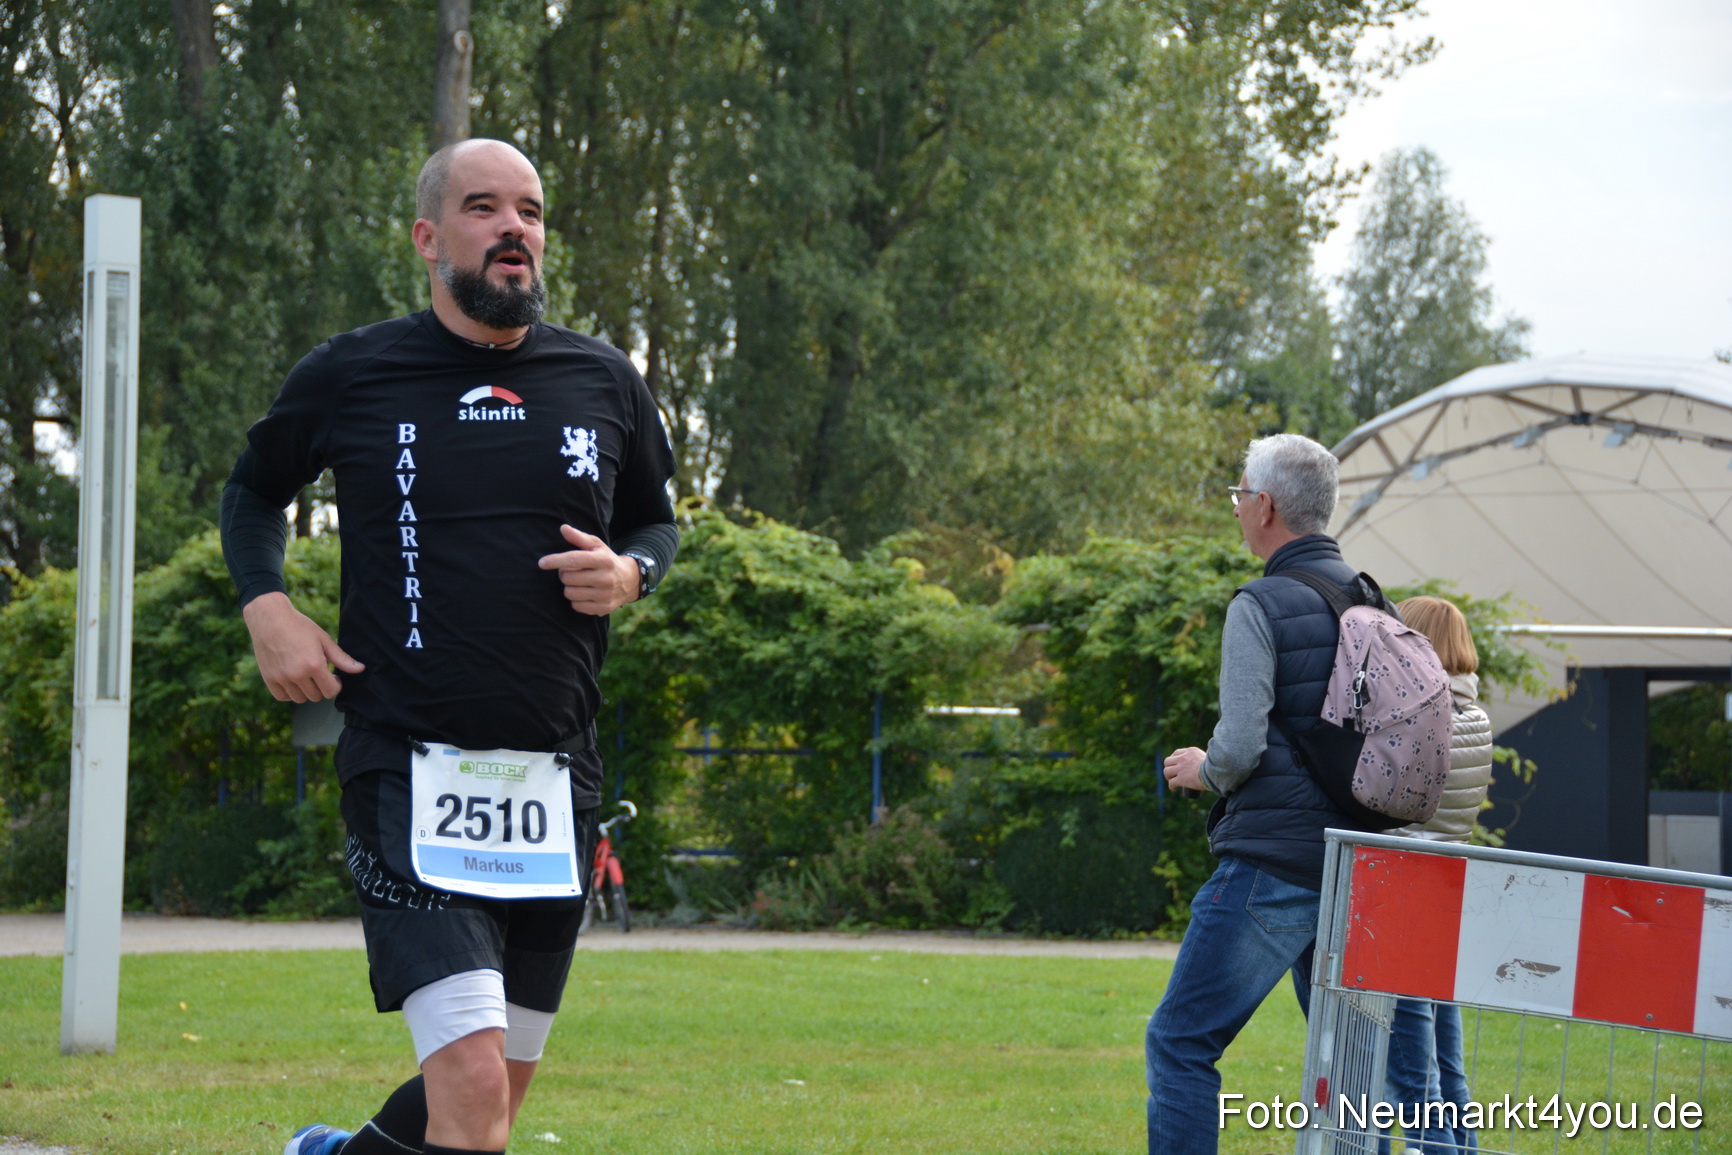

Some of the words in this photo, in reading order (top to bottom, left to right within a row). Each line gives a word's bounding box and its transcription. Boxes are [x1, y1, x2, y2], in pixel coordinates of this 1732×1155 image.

[458, 406, 526, 421] skinfit
[396, 423, 423, 648] BAVARTRIA
[476, 761, 528, 778] BOCK
[435, 793, 547, 844] 2510
[420, 830, 426, 838] D
[464, 856, 524, 874] Markus
